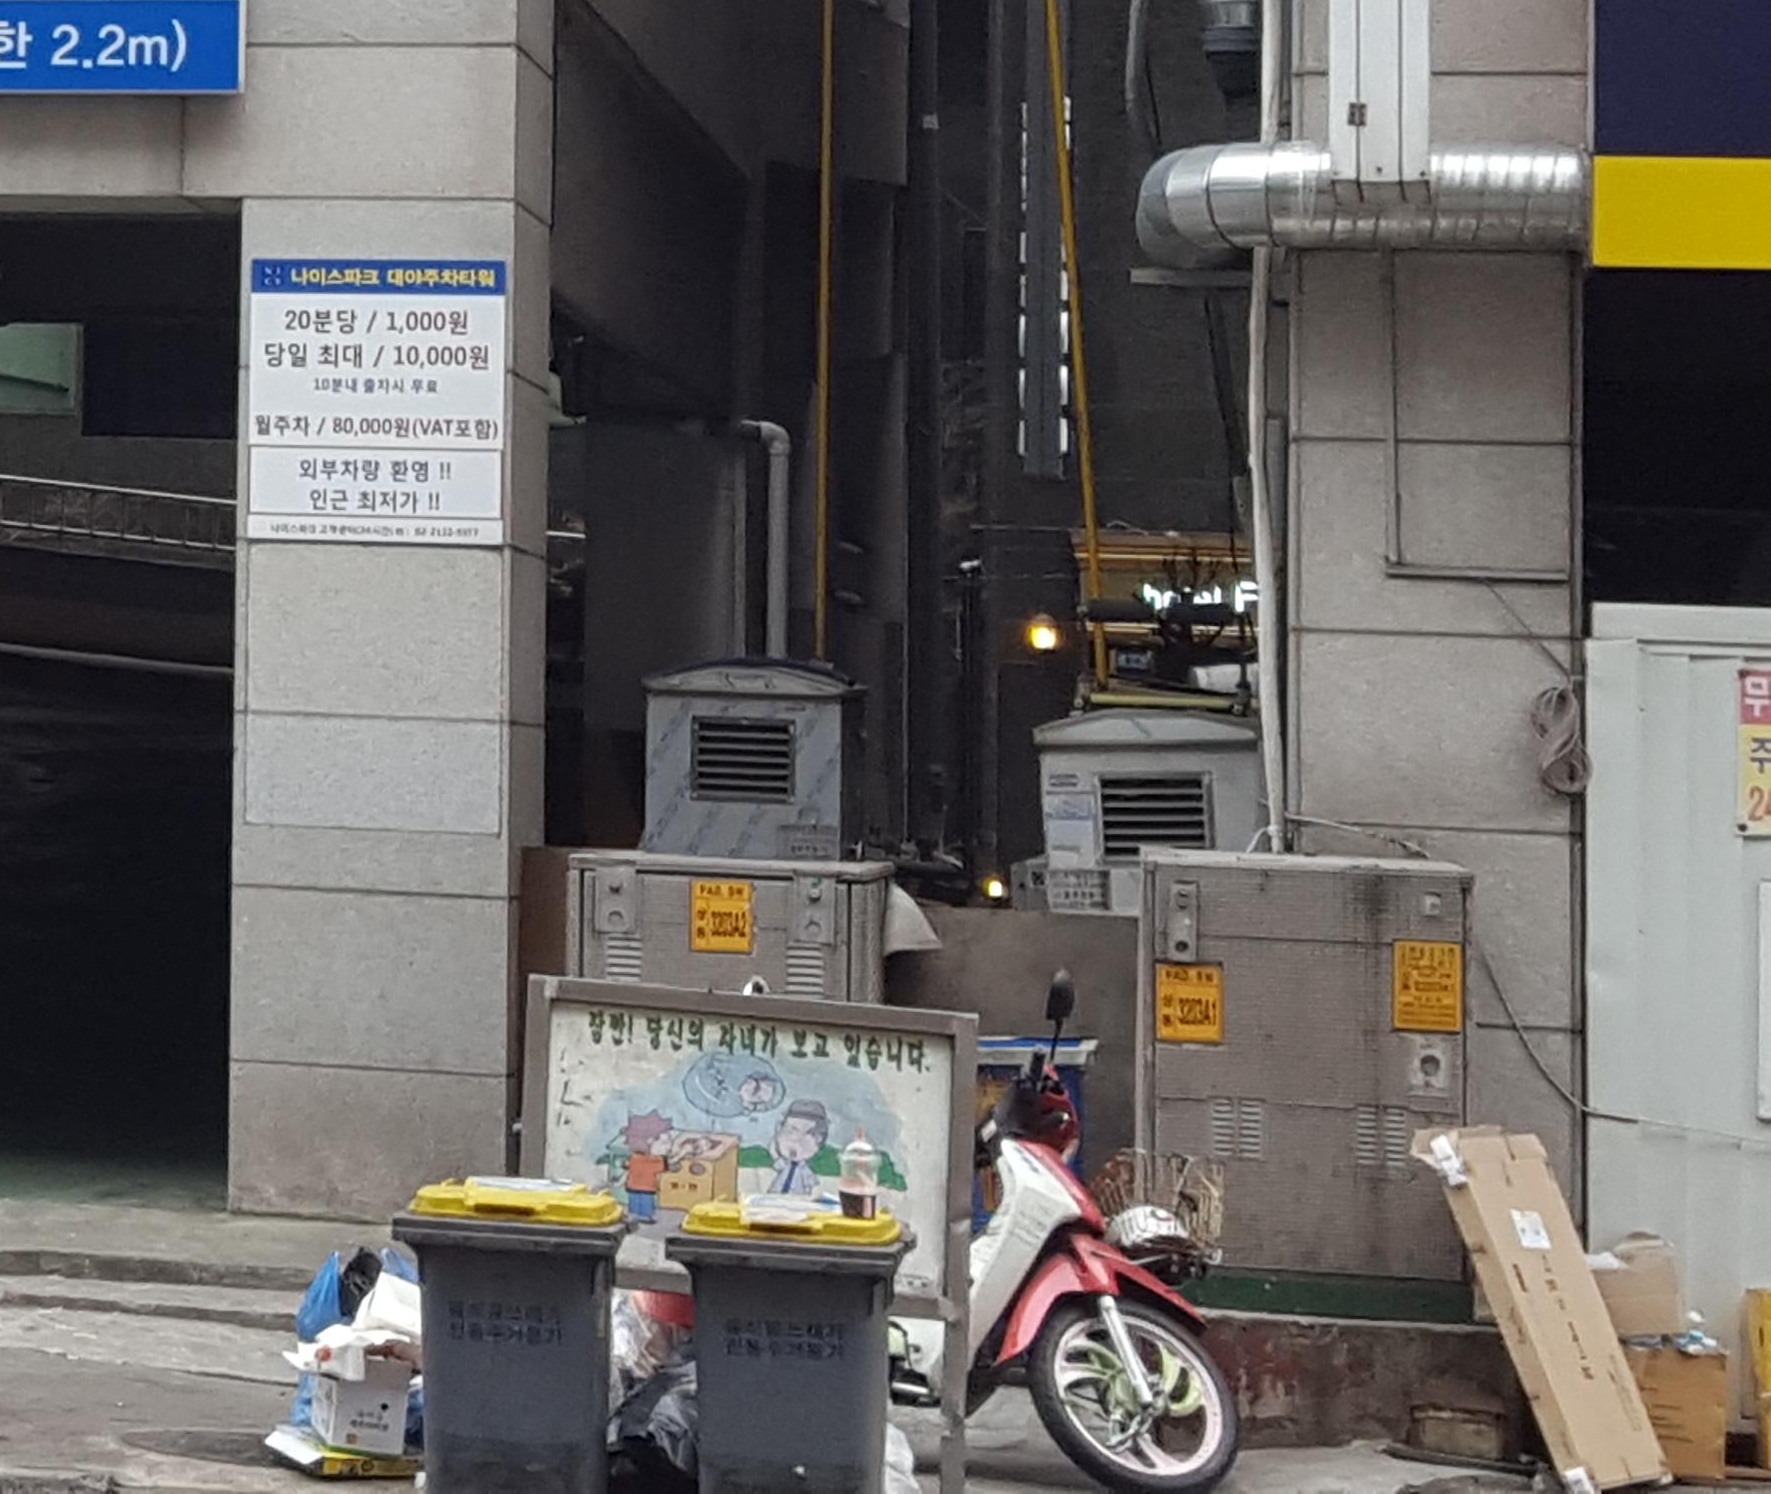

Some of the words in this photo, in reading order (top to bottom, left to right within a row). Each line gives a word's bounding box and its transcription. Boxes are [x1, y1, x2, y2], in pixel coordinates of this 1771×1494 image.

[51, 20, 188, 72] 2.2m)
[291, 268, 379, 286] 나이스파크
[285, 309, 357, 334] 20분당
[387, 310, 468, 335] 1,000원
[264, 342, 308, 368] 당일
[318, 344, 362, 368] 최대
[394, 345, 489, 370] 10,000원
[256, 415, 309, 436] 월주차
[299, 458, 380, 482] 외부차량
[390, 460, 429, 482] 환영
[309, 489, 349, 511] 인근
[357, 491, 419, 513] 최저가
[646, 1016, 704, 1051] 당신의
[718, 1022, 778, 1057] 자녀가
[791, 1029, 830, 1059] 보고
[843, 1034, 930, 1074] 있습니다.
